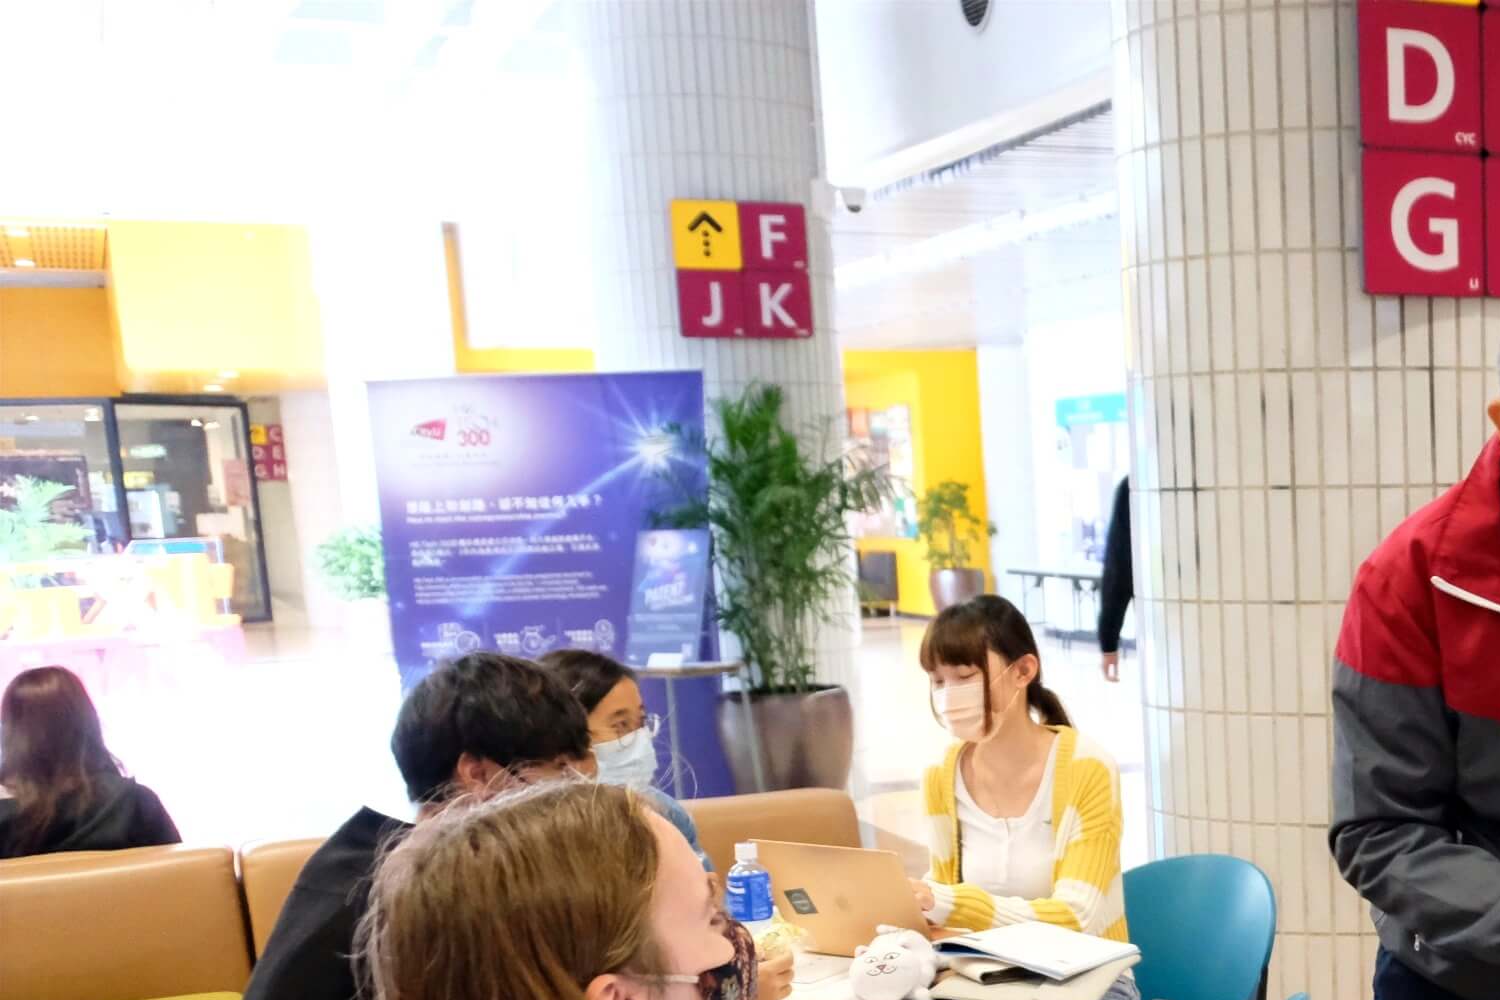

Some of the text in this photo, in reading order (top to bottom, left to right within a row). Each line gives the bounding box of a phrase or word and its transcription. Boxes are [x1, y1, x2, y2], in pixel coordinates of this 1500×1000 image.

[1386, 27, 1455, 124] D
[1455, 132, 1475, 146] CYC
[759, 214, 787, 260] F
[1391, 177, 1459, 272] G
[701, 281, 723, 327] J
[759, 283, 797, 328] K
[457, 428, 491, 447] 300
